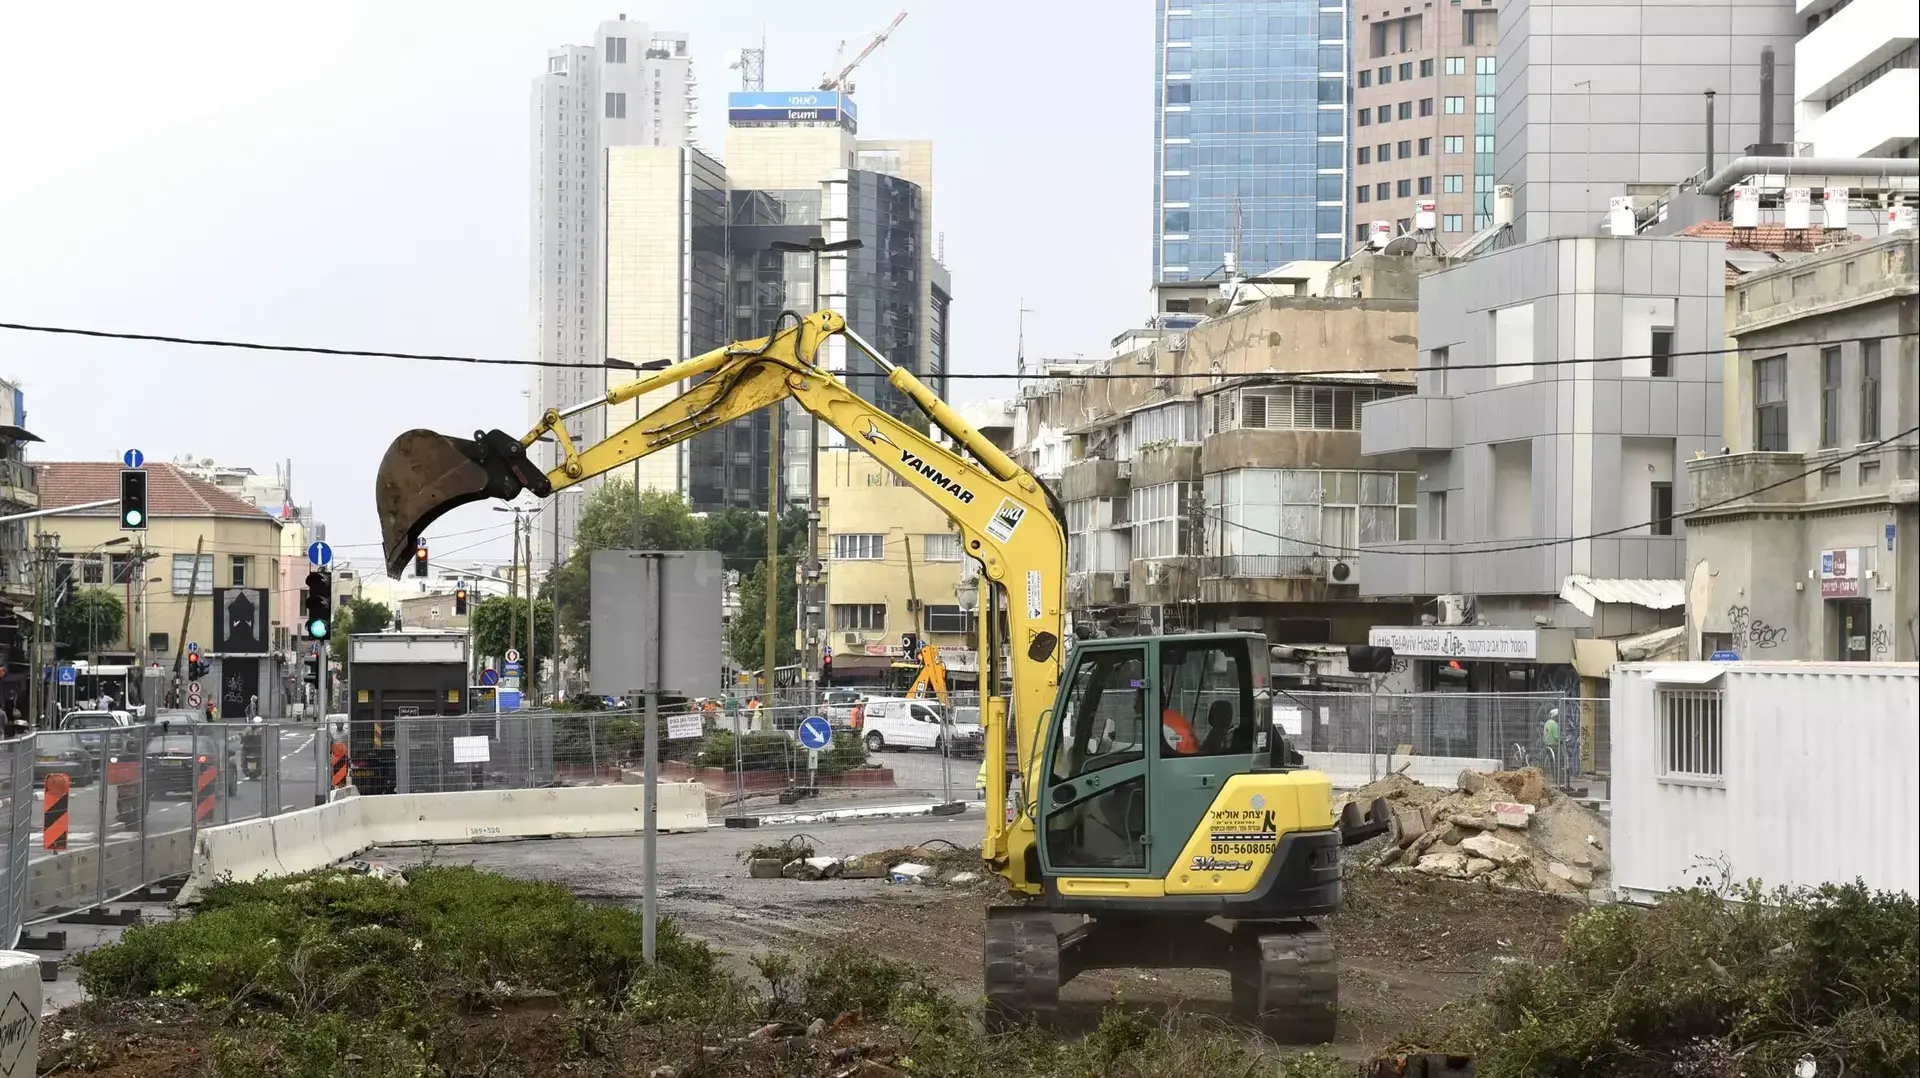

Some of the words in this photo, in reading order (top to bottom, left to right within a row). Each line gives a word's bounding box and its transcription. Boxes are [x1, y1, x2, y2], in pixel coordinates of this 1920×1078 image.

[788, 95, 818, 105] לאומי
[788, 109, 818, 119] leumi
[900, 449, 975, 504] YANMAR
[999, 507, 1023, 521] HKL
[1417, 635, 1439, 651] Hostel
[1211, 810, 1240, 819] אוליאל
[1243, 810, 1263, 819] יצחק
[1211, 844, 1276, 854] 050-5608050
